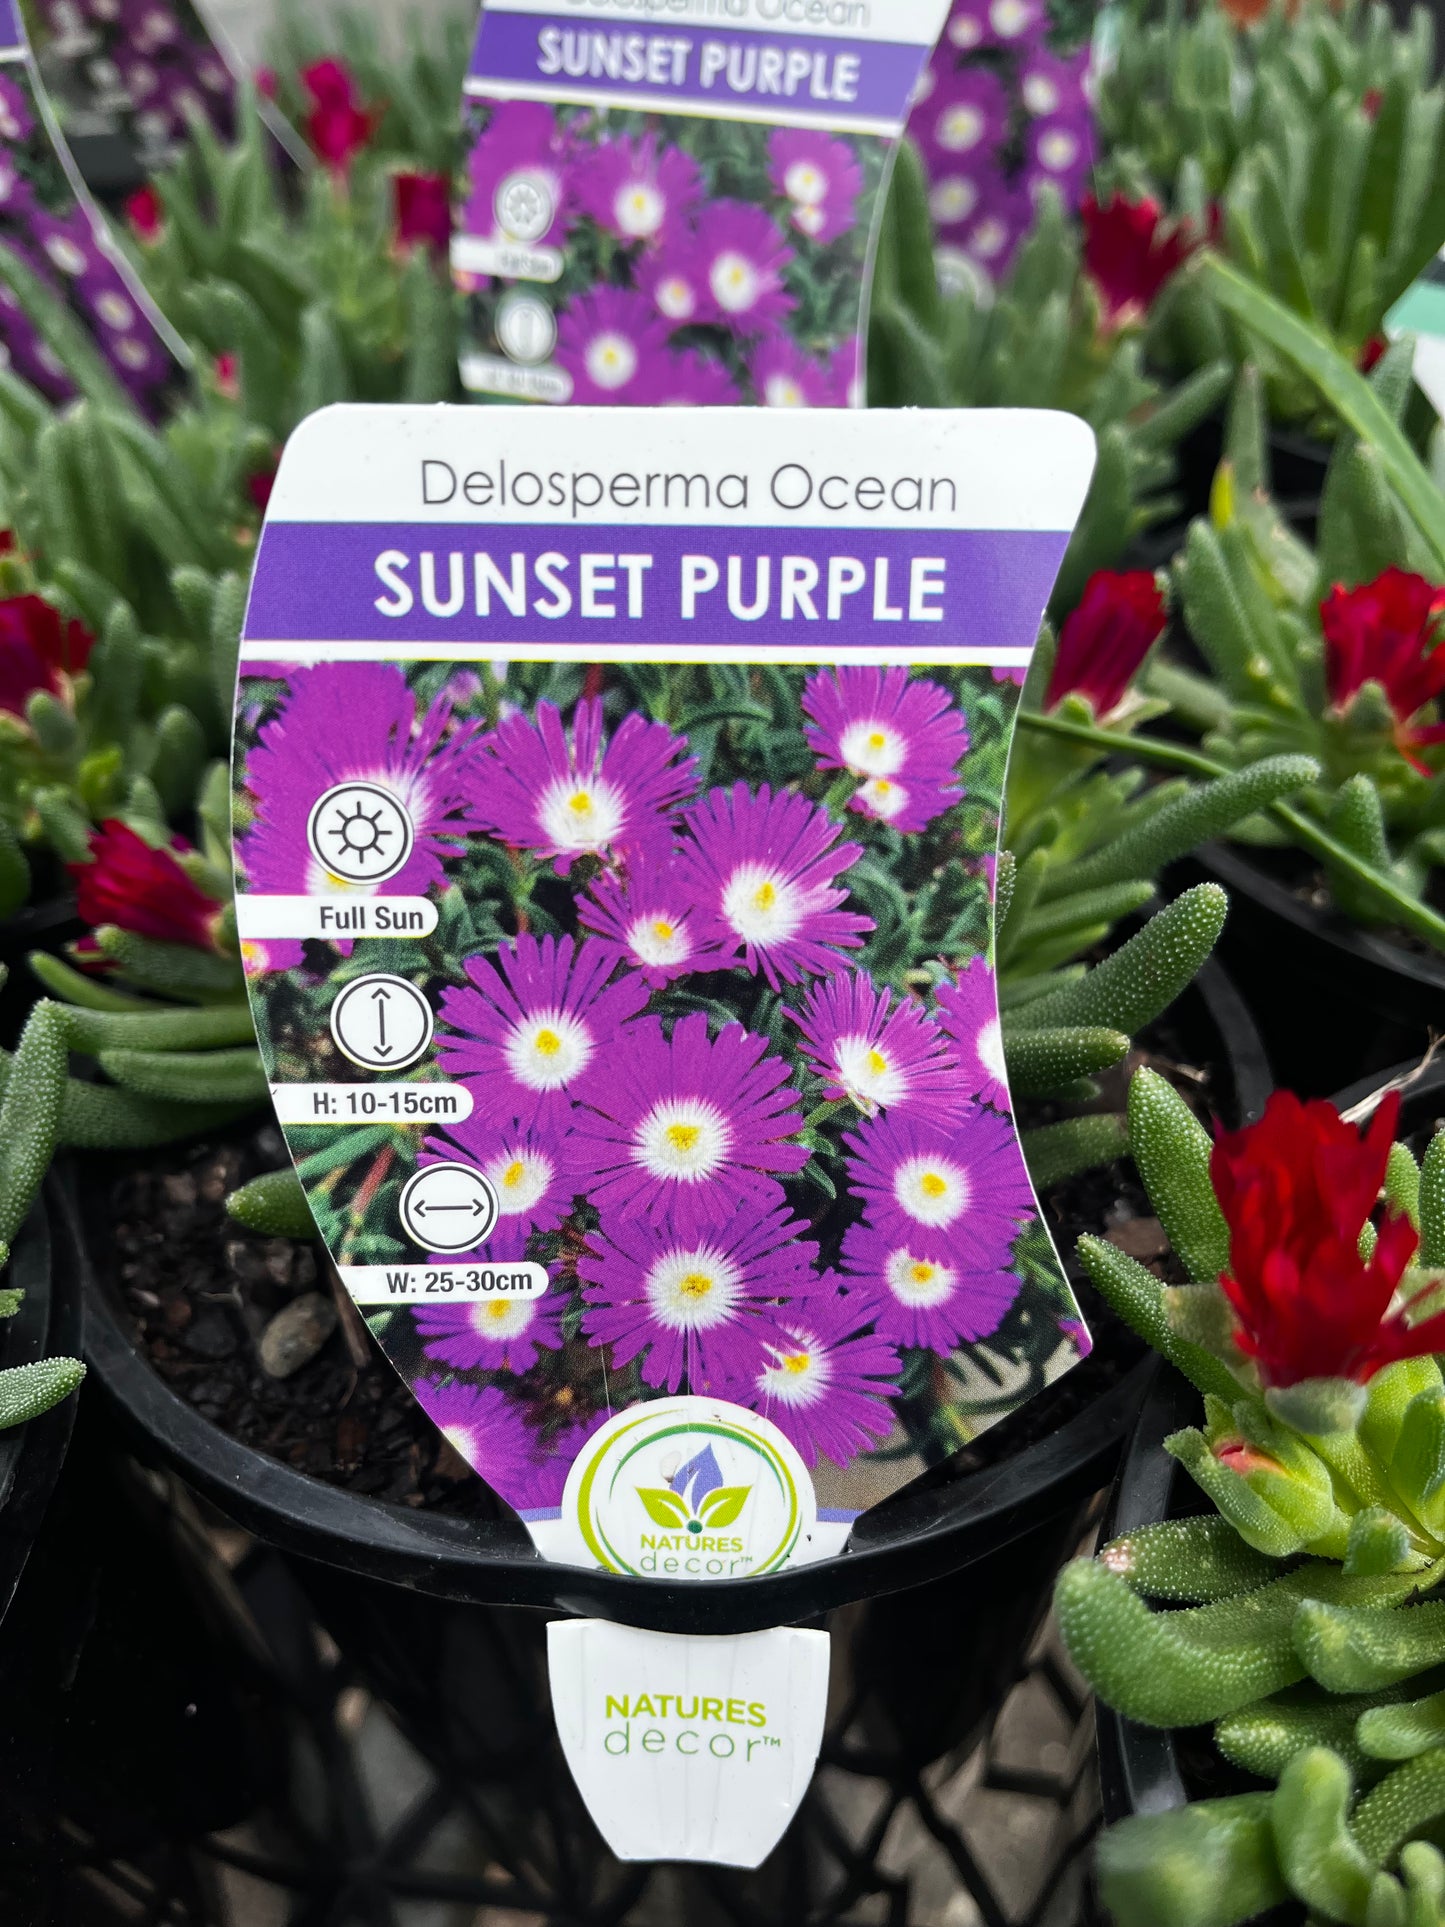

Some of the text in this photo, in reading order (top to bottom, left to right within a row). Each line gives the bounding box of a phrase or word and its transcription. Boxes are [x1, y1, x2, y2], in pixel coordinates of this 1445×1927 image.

[755, 0, 871, 28] Ocean
[536, 25, 862, 101] SUNSET PURPLE
[421, 459, 958, 518] Delosperma Ocean
[374, 550, 946, 622] SUNSET PURPLE
[319, 905, 424, 930] Full Sun
[313, 1092, 458, 1115] H: 10-15cm
[386, 1270, 533, 1294] W: 25-30cm
[640, 1534, 743, 1552] NATURES
[605, 1693, 767, 1728] NATURES
